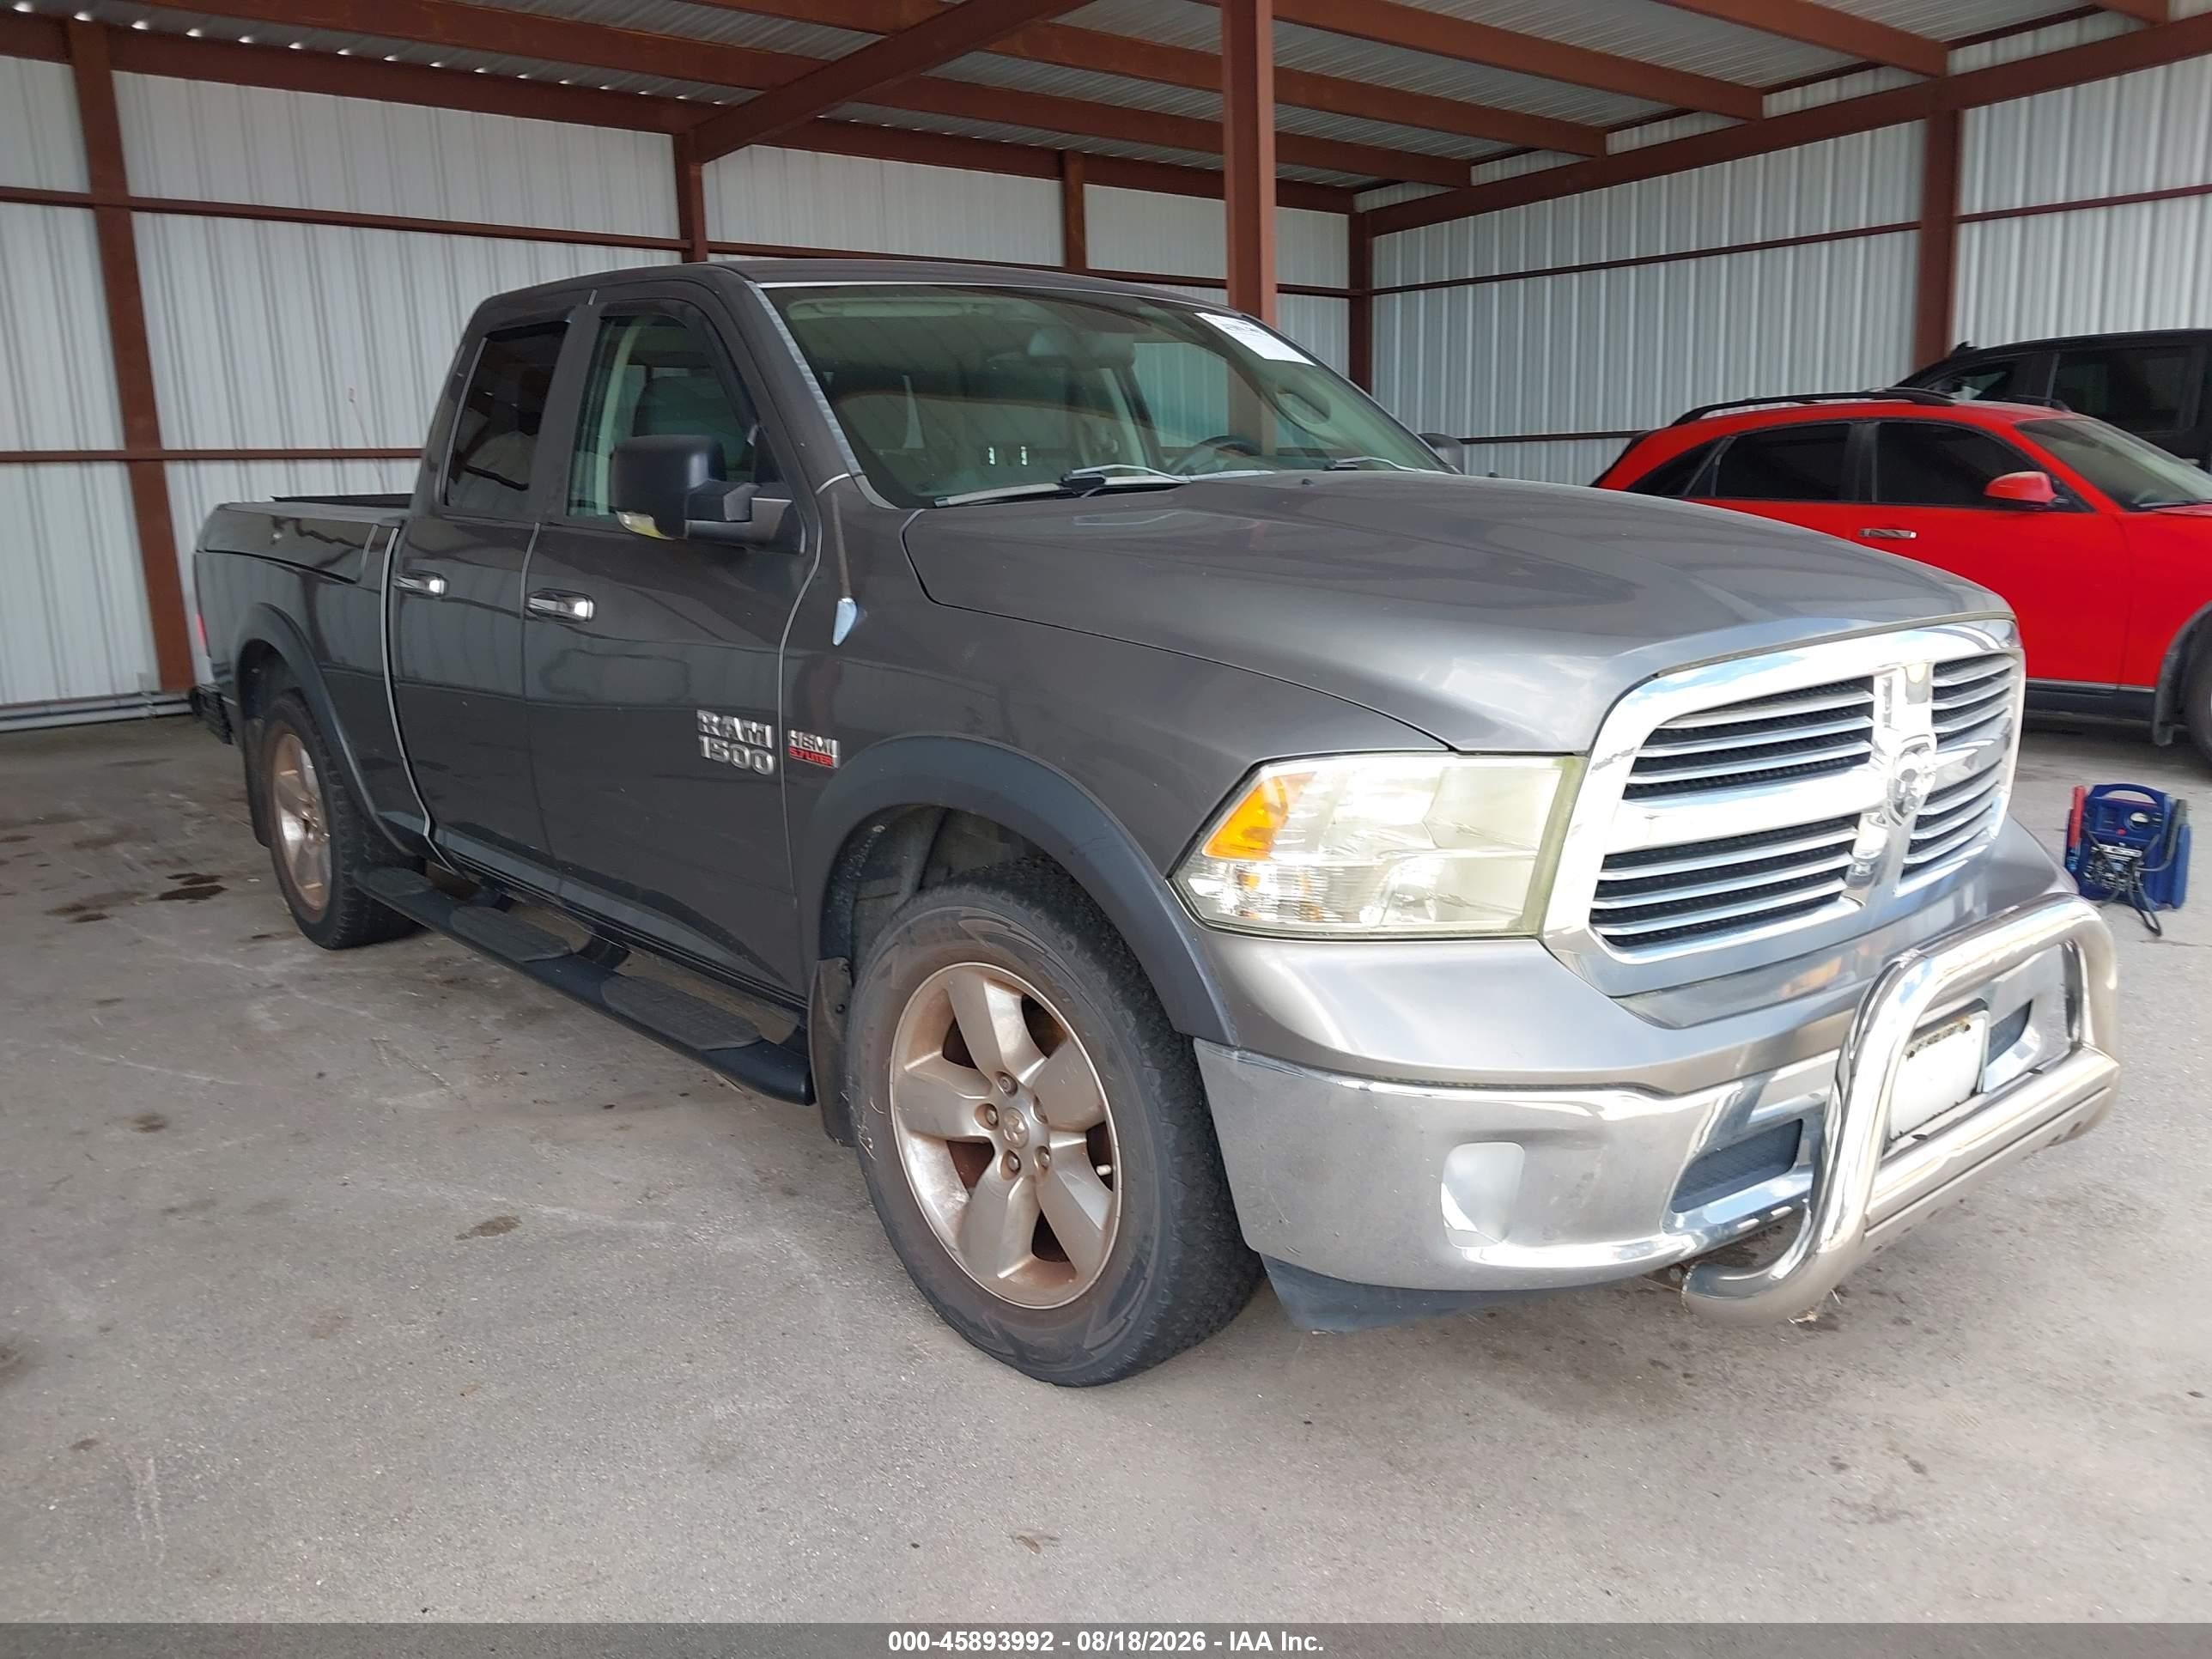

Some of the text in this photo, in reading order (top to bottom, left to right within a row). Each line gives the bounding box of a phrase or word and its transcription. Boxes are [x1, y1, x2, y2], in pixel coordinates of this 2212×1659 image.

[696, 709, 772, 749] RAM
[788, 729, 838, 758] HEMI
[698, 734, 775, 775] 1500
